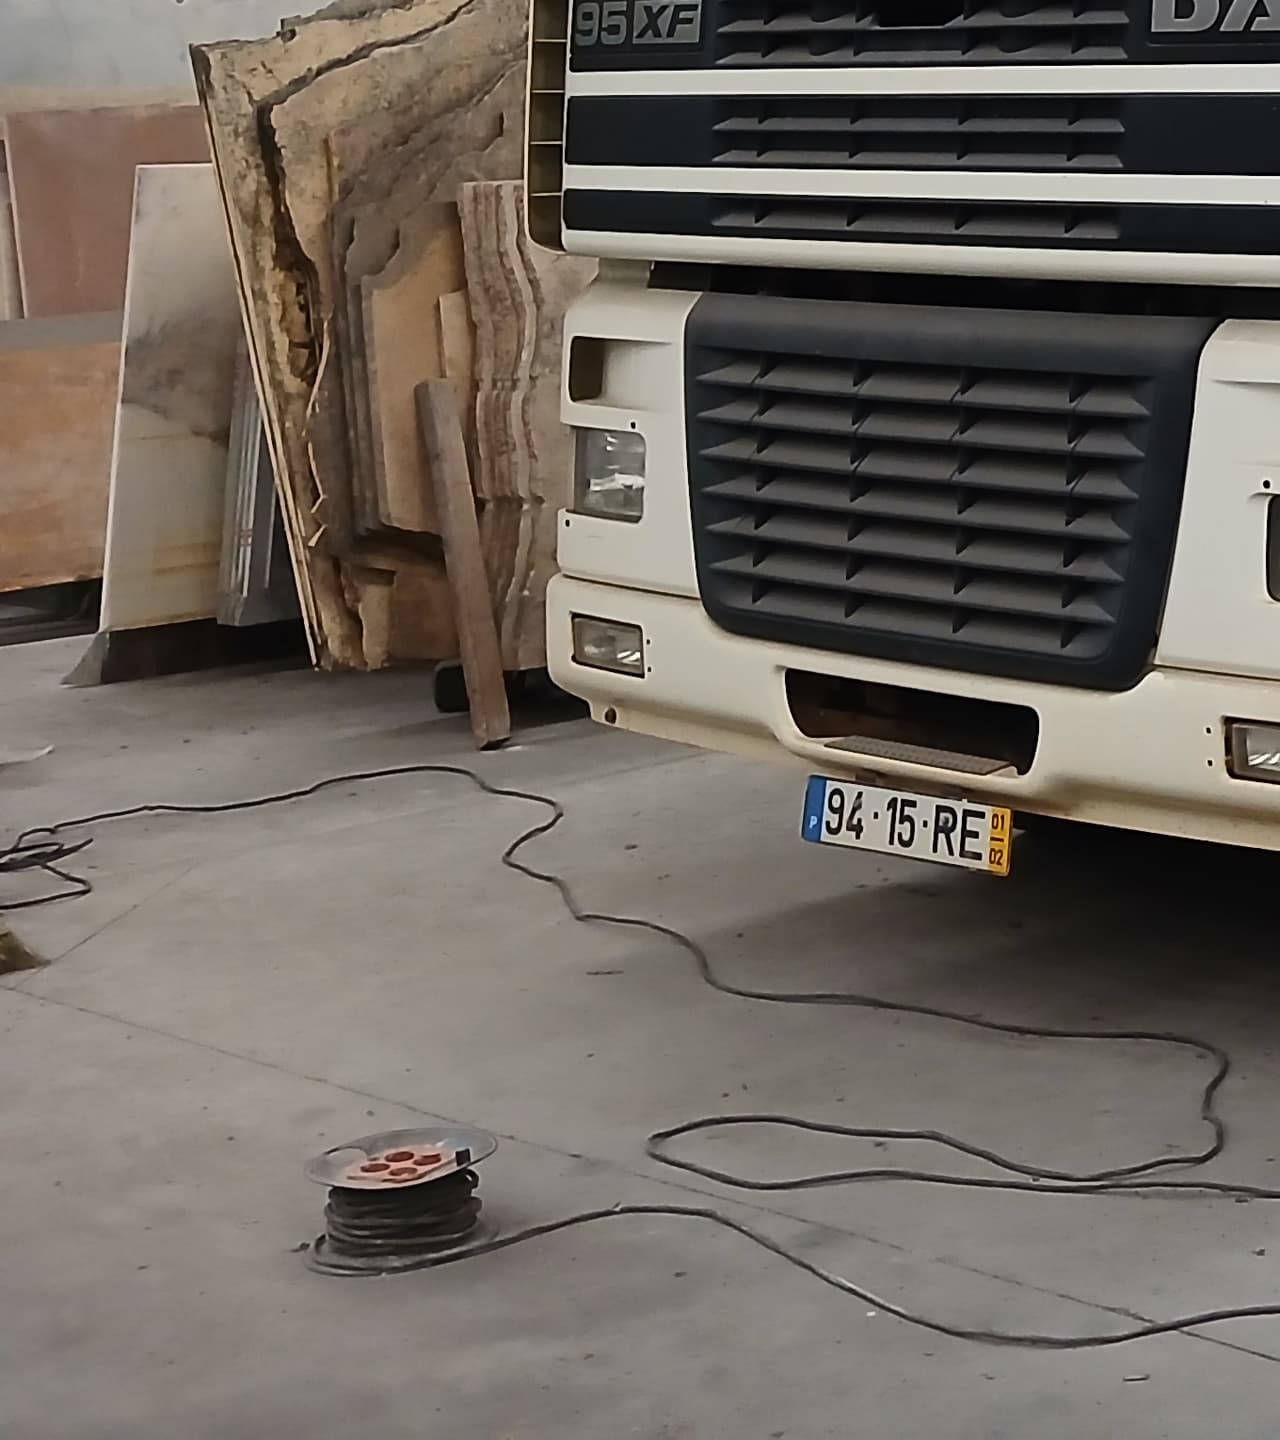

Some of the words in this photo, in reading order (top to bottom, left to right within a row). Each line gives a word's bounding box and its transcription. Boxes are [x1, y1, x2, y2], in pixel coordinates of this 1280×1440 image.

[809, 816, 818, 829] P
[992, 813, 1005, 831] 01
[989, 848, 1004, 866] 02
